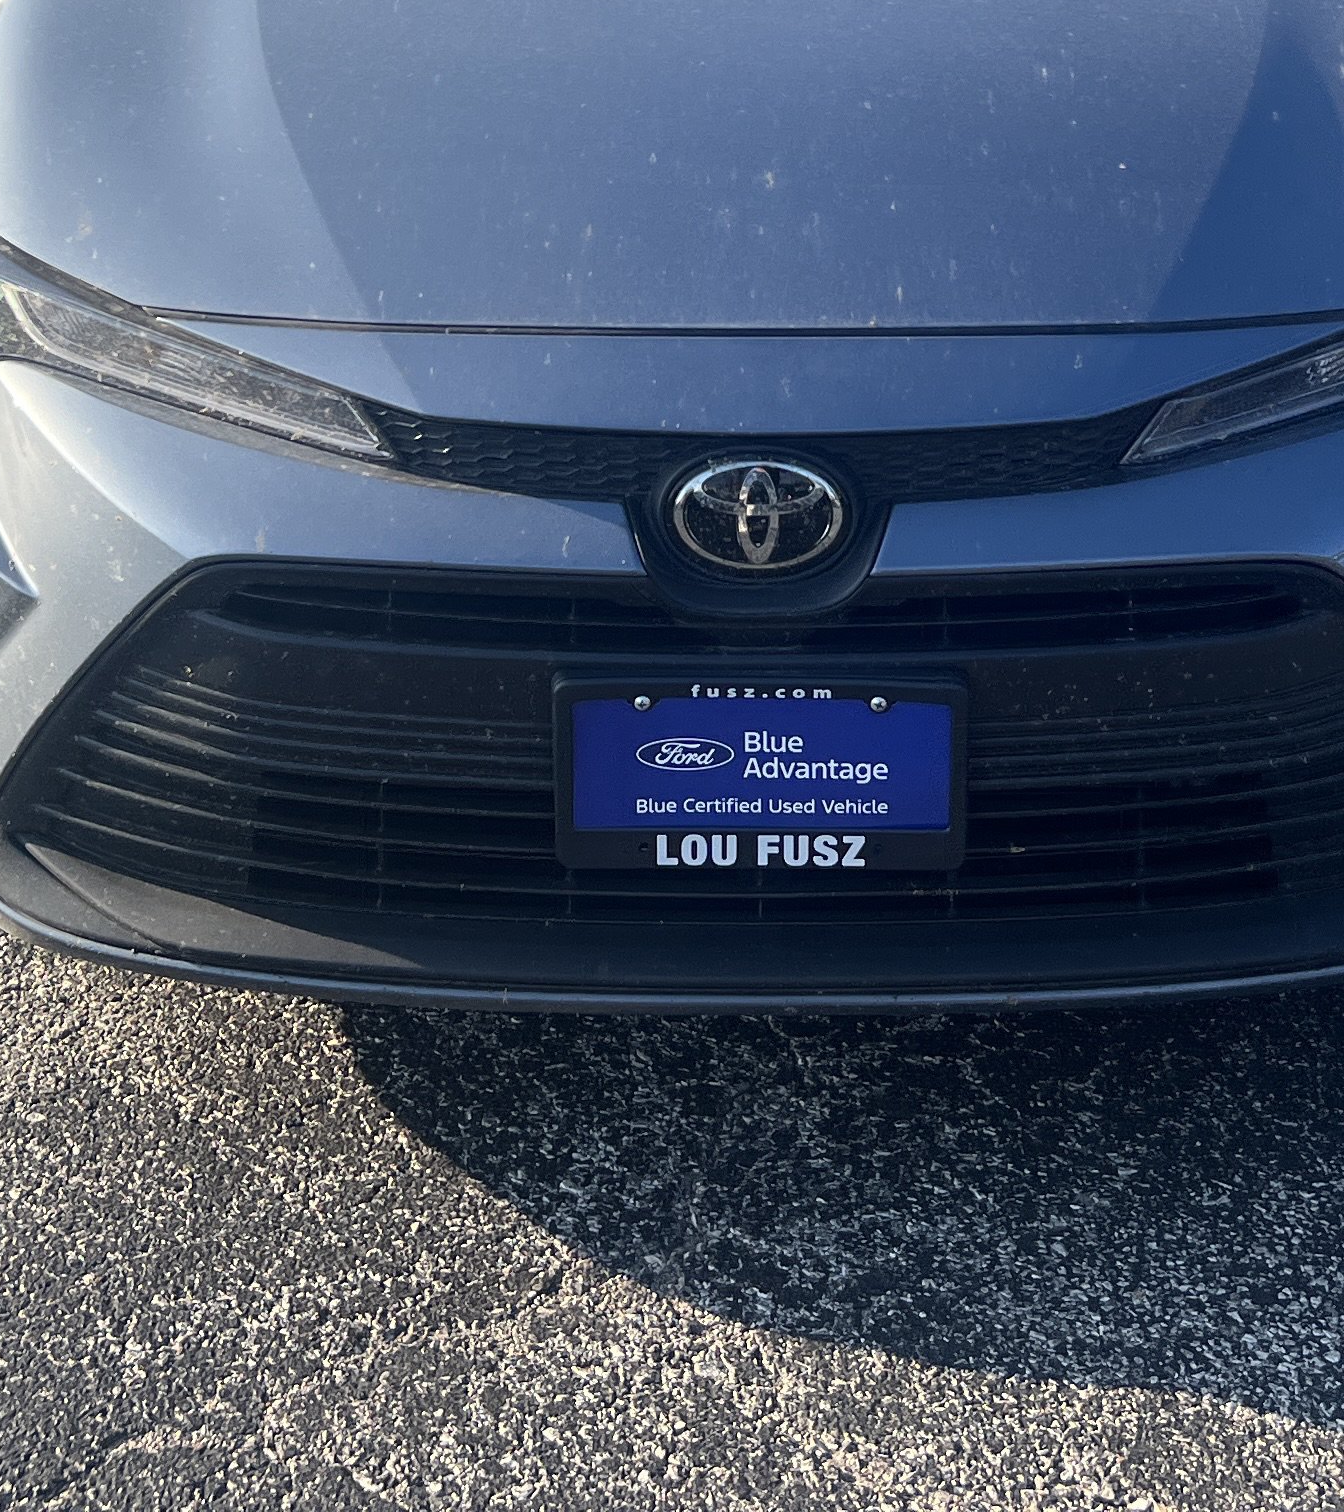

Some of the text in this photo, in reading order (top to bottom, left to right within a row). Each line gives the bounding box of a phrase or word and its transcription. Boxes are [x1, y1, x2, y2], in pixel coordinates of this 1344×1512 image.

[690, 684, 833, 699] fusz.com
[744, 731, 804, 754] Blue
[655, 743, 715, 767] Ford
[743, 756, 889, 784] Advantage
[636, 797, 889, 815] Blue Certified Used Vehicle
[656, 834, 866, 868] LOU FUSZ
